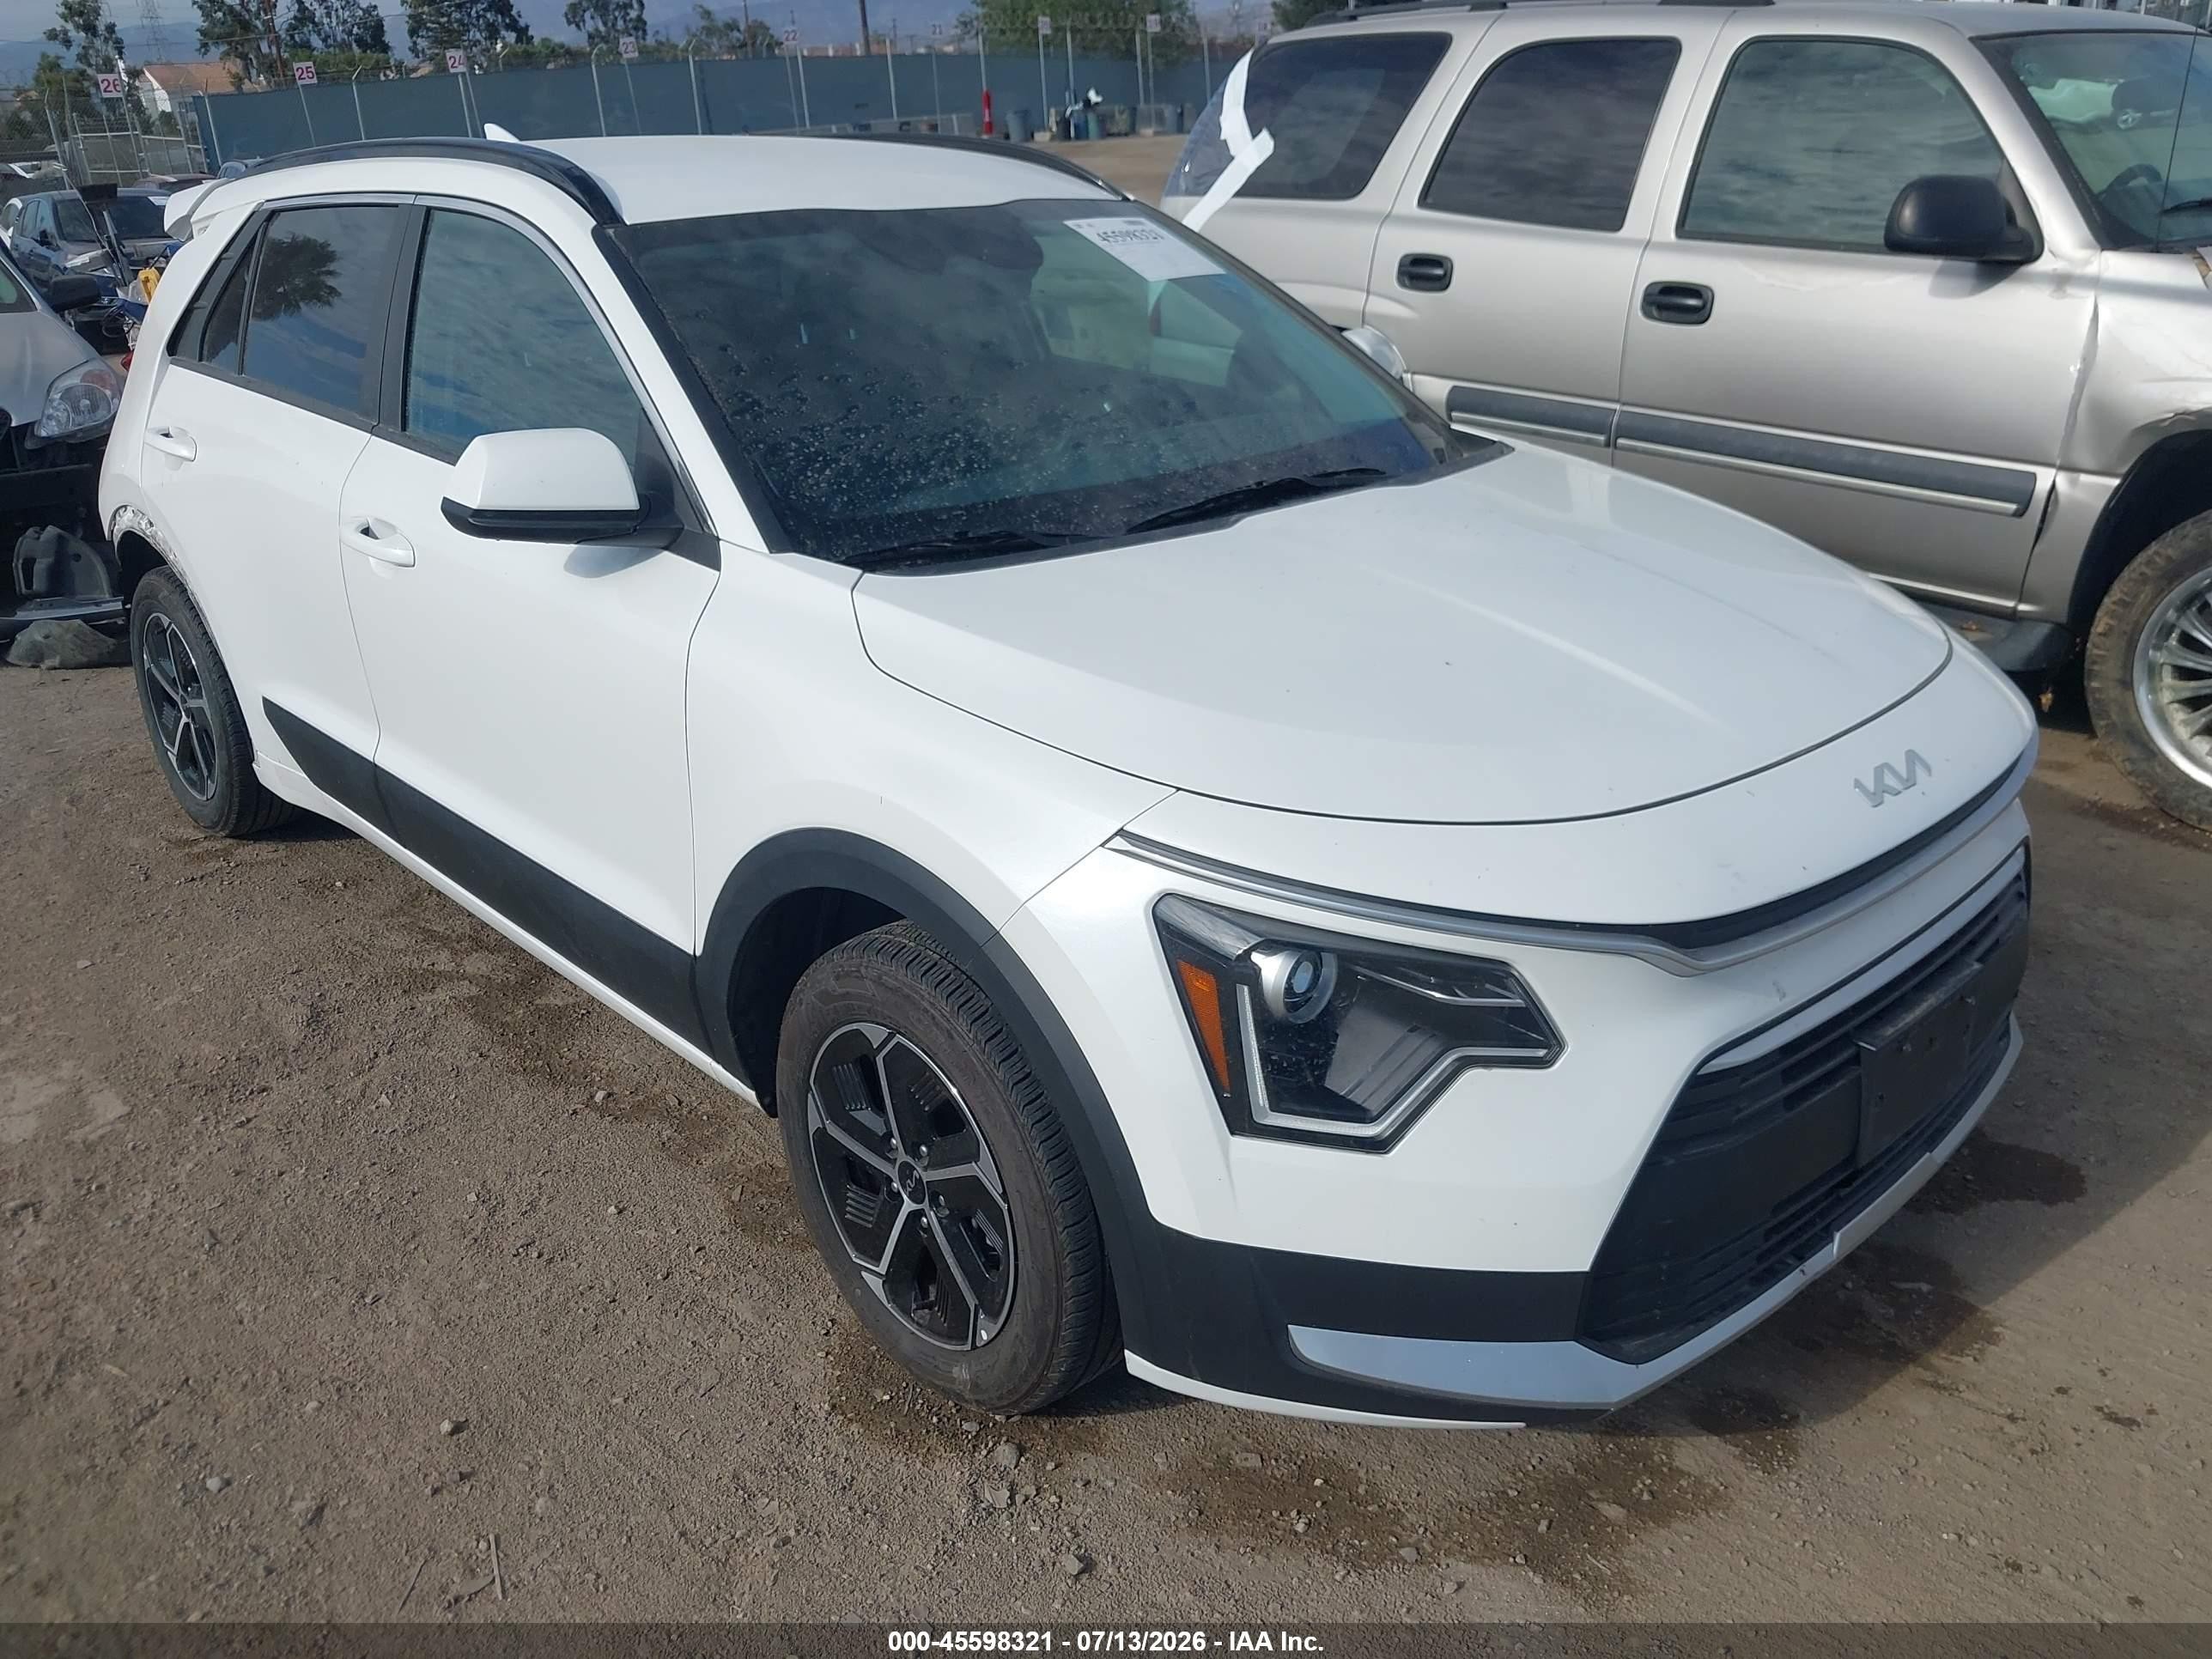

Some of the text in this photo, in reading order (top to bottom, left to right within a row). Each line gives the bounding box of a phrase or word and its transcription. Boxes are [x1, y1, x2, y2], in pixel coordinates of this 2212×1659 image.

[783, 29, 798, 42] 22
[295, 65, 315, 81] 25
[1853, 748, 1931, 808] KIA
